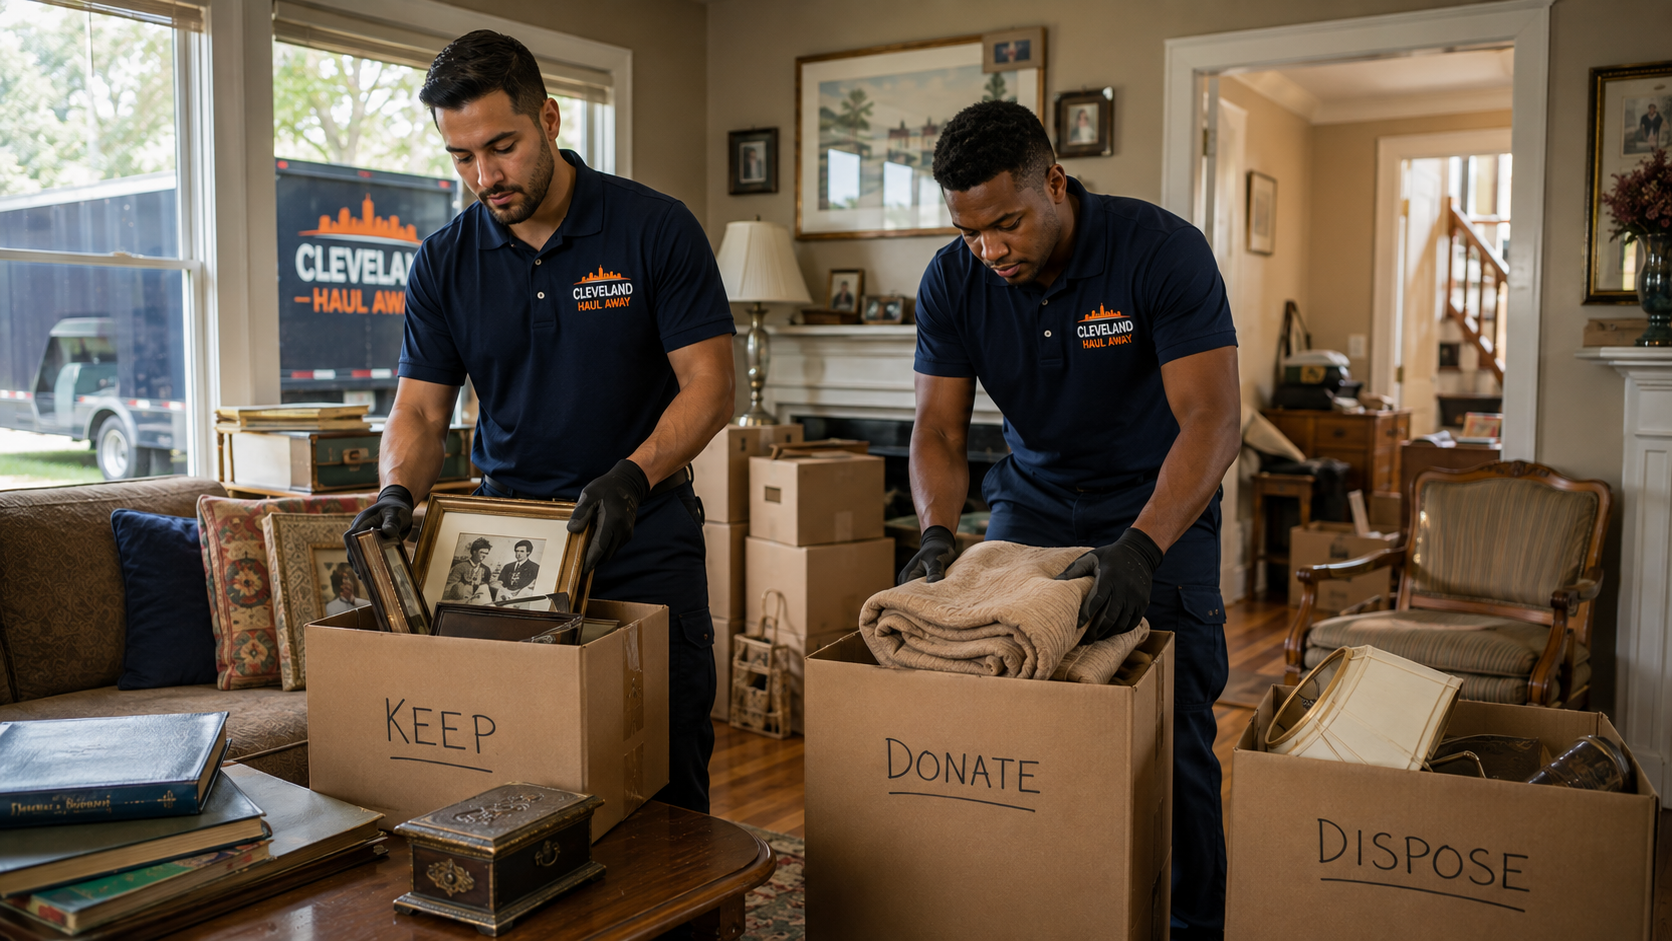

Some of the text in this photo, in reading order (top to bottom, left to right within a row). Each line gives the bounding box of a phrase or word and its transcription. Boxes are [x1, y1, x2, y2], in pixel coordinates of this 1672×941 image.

[295, 243, 416, 286] CLEVELA
[313, 287, 405, 315] HAUL AW
[573, 283, 633, 300] CLEVELAND
[578, 297, 631, 311] HAUL AWAY
[1077, 320, 1134, 338] CLEVELAND
[1083, 334, 1132, 349] HAUL AWAY
[385, 697, 497, 754] KEEP
[885, 737, 1041, 794] DONATE
[1317, 817, 1531, 893] DISPOSE
